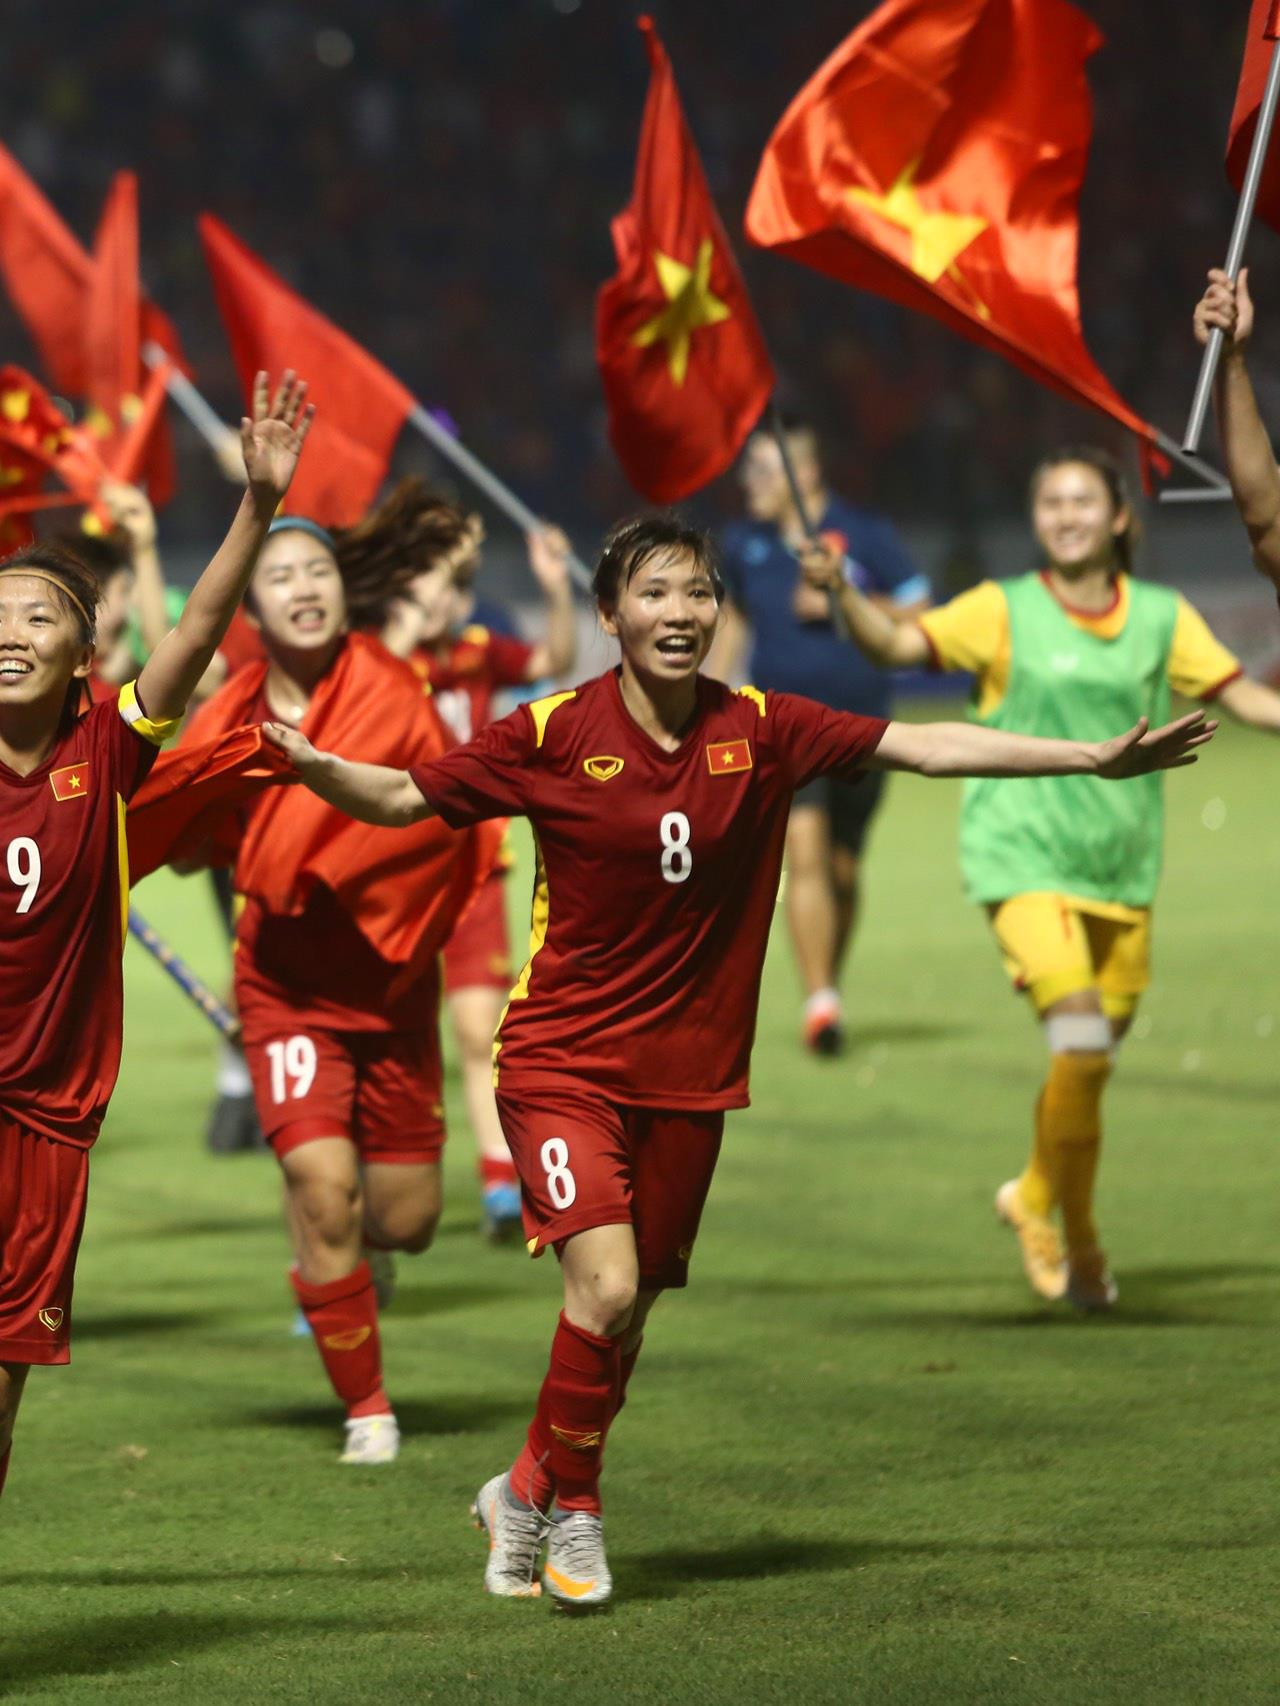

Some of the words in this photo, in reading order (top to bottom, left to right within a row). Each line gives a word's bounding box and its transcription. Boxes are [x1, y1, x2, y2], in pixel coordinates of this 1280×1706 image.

[6, 836, 42, 914] 9
[659, 811, 693, 883] 8
[265, 1034, 318, 1105] 19
[540, 1137, 577, 1210] 8
